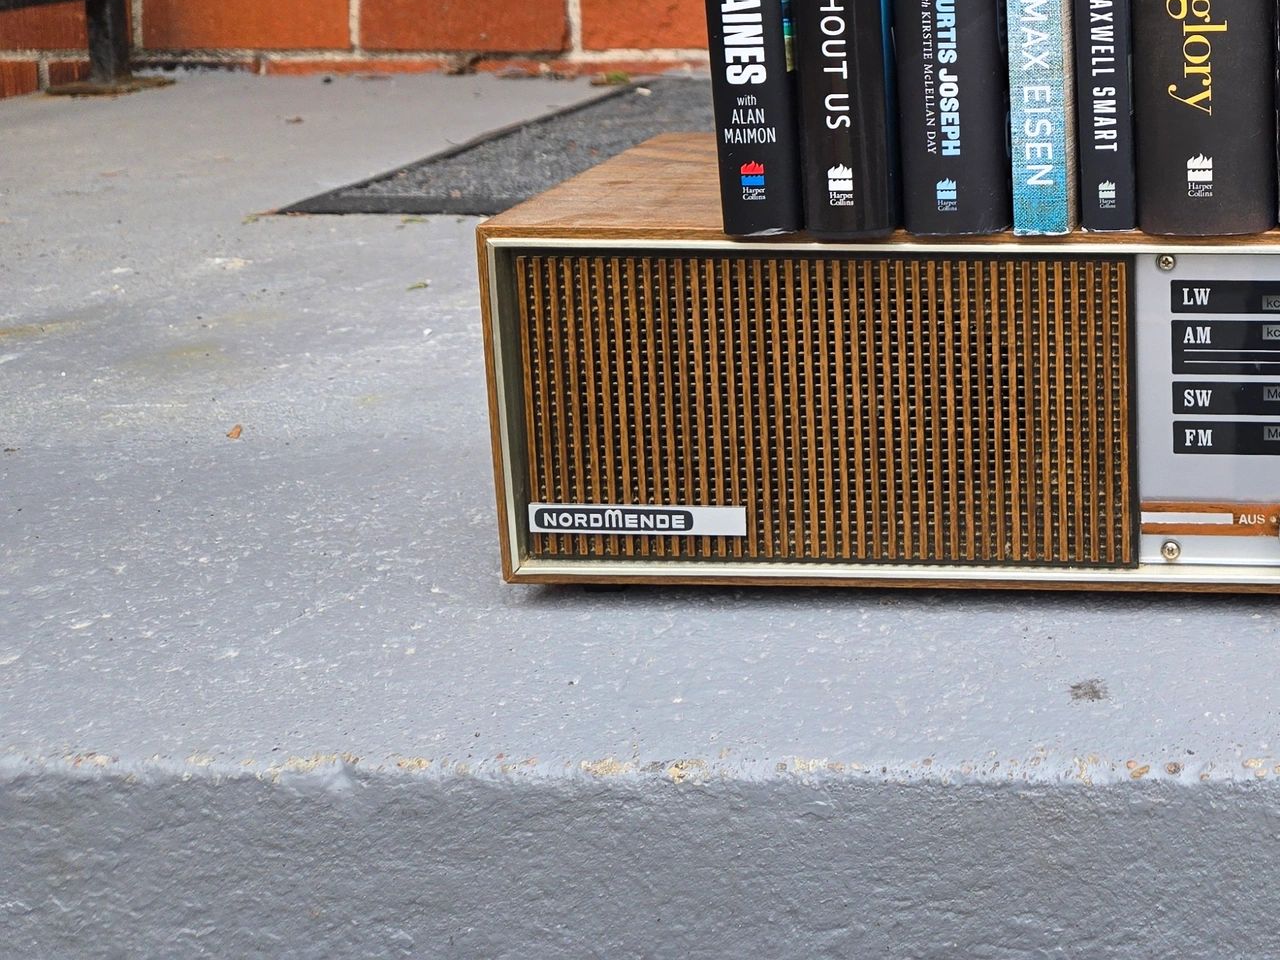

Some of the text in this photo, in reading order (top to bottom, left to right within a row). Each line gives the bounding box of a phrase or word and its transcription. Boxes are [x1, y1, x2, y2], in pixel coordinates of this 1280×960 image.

[922, 12, 932, 60] KIRSTIE
[736, 95, 757, 107] with
[924, 63, 936, 126] McLELLAN
[732, 109, 765, 124] ALAN
[824, 94, 851, 130] US
[938, 69, 961, 156] JOSEPH
[1092, 86, 1118, 152] SMART
[724, 127, 776, 144] MAIMON
[926, 131, 936, 155] DAY
[1023, 85, 1054, 187] EISEN
[1182, 288, 1211, 305] LW
[1266, 298, 1280, 308] kc
[1183, 326, 1212, 344] AM
[1266, 327, 1280, 338] kc
[1183, 389, 1212, 407] SW
[1184, 429, 1213, 447] FM
[543, 508, 686, 529] NORDMENDE
[1238, 513, 1266, 526] AUS
